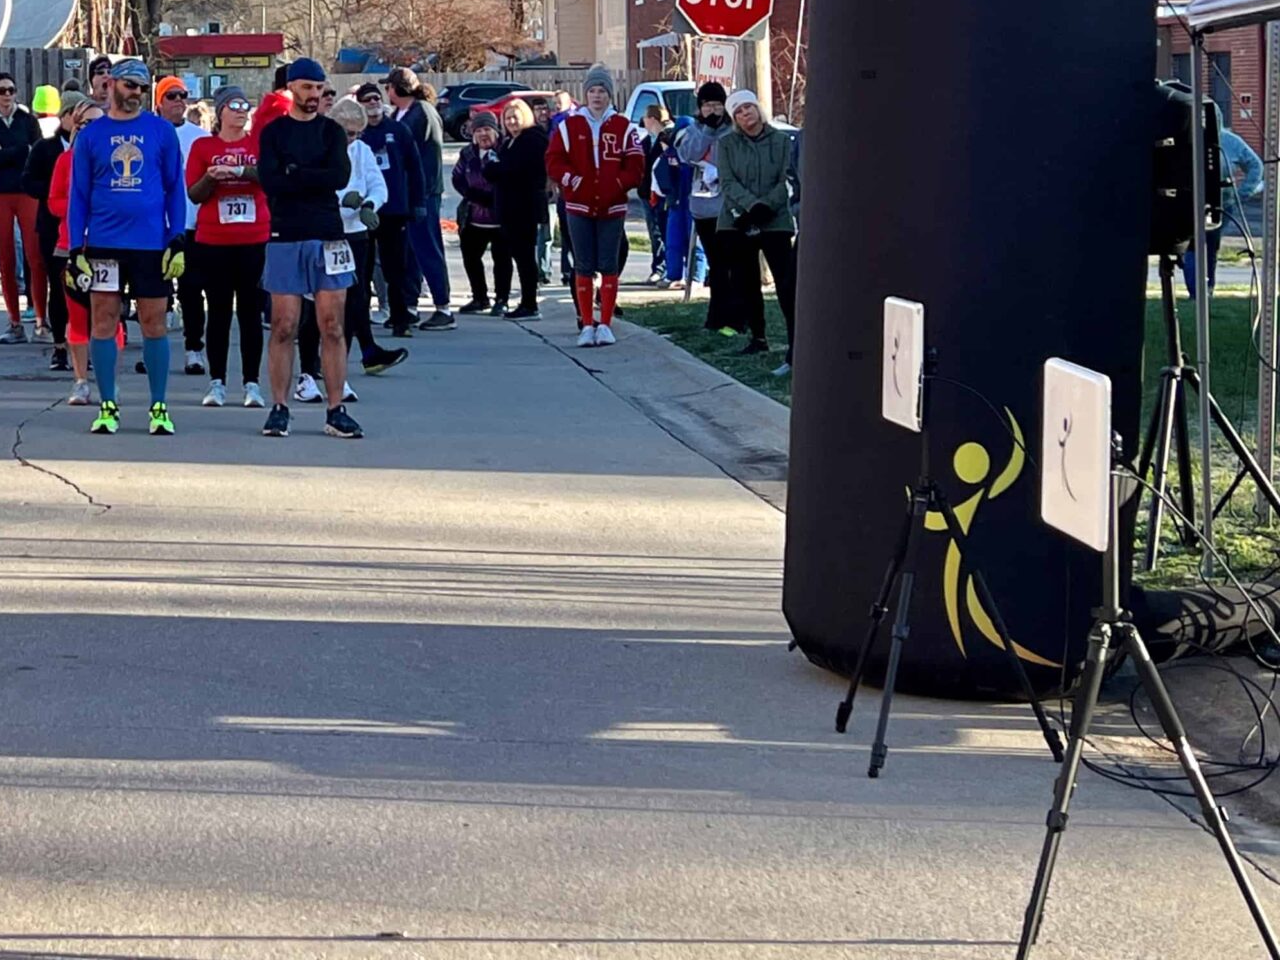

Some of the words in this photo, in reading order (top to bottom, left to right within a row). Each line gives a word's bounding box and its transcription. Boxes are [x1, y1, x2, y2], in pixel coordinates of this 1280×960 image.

[710, 55, 724, 69] NO
[111, 135, 144, 145] RUN
[111, 177, 142, 188] HSP
[226, 202, 248, 215] 737
[94, 268, 110, 284] 12
